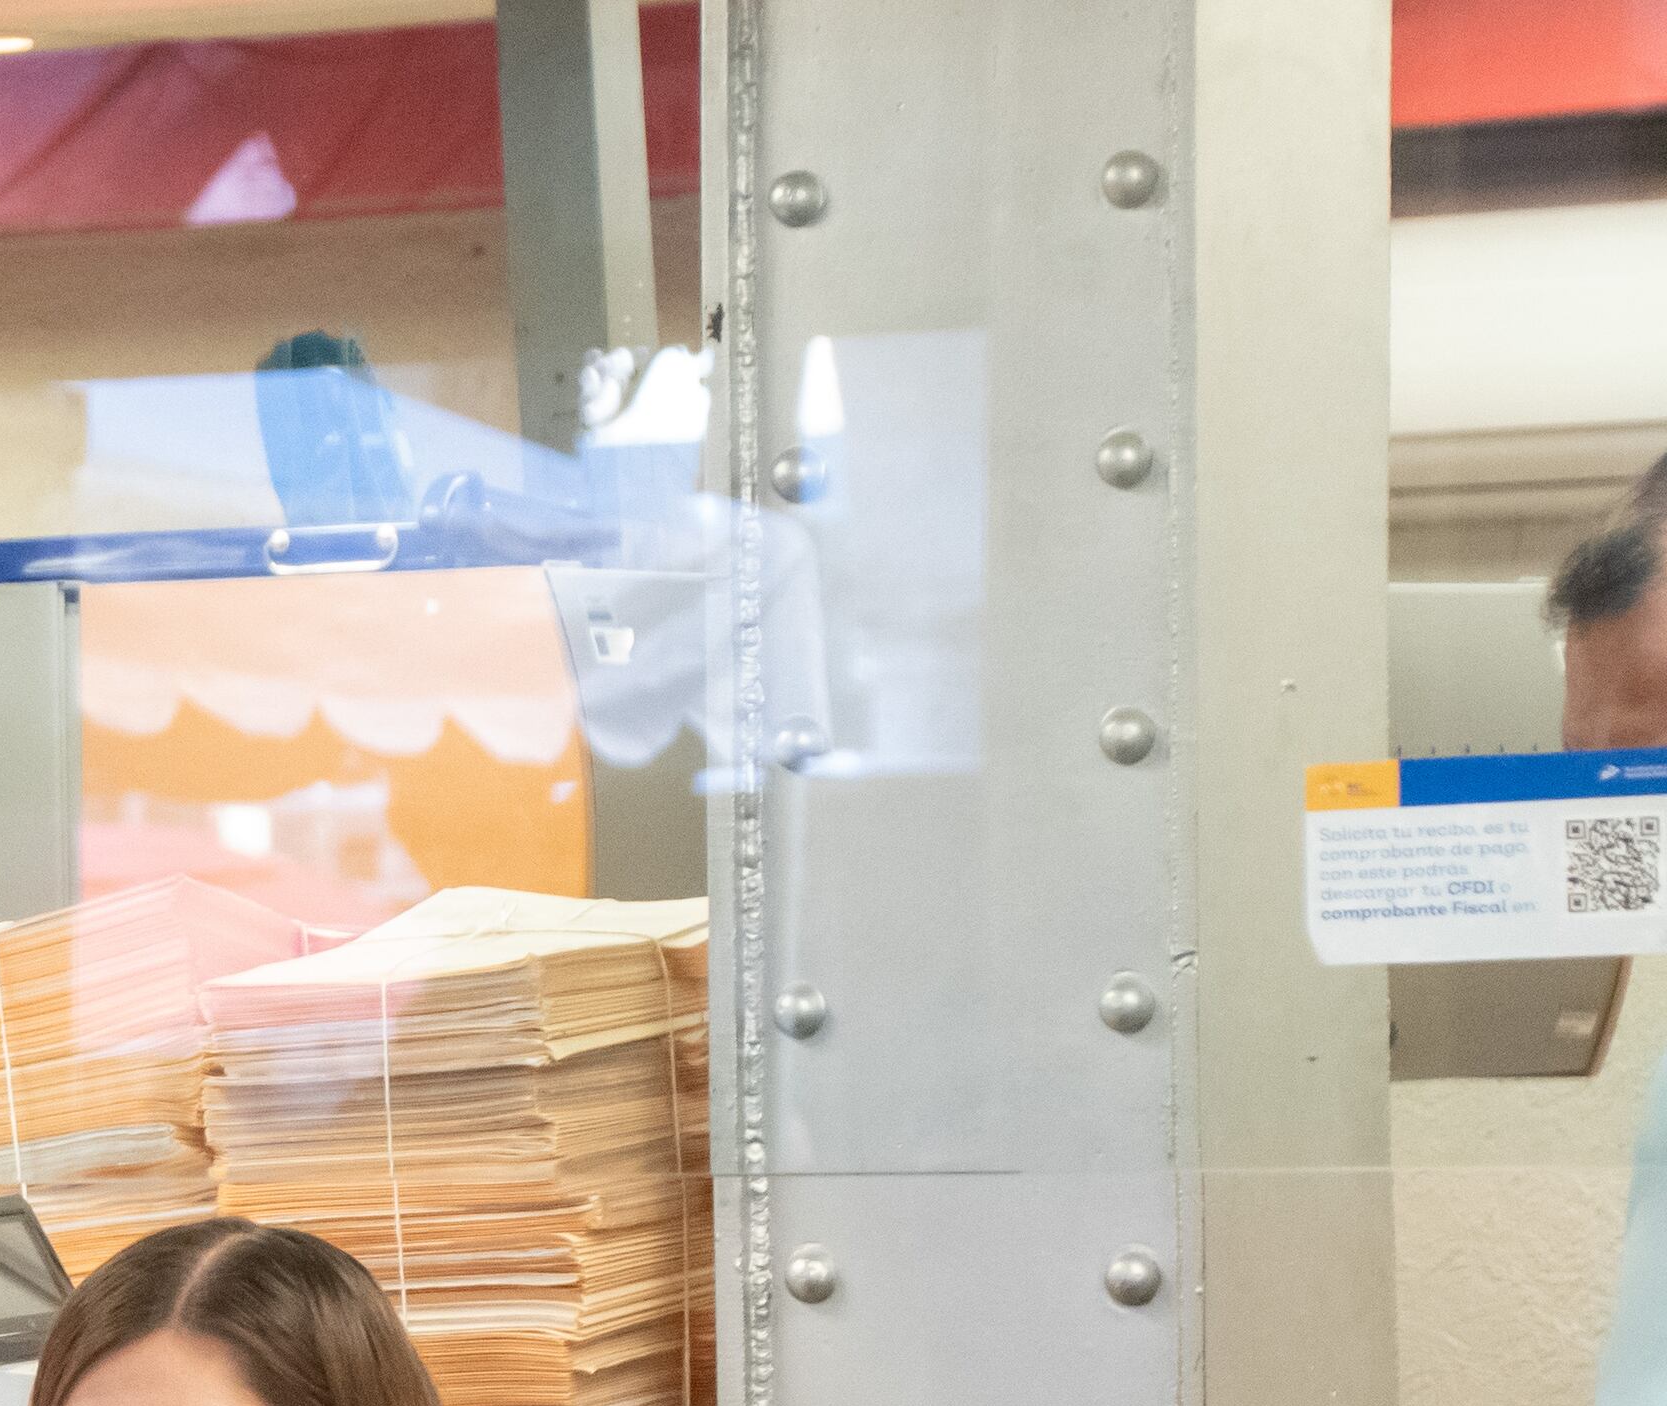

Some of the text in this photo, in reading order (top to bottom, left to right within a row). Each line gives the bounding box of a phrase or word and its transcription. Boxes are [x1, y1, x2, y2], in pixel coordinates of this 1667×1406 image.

[1447, 879, 1495, 896] CFDI
[1320, 902, 1448, 921] comprobante
[1452, 899, 1507, 914] Fiscal
